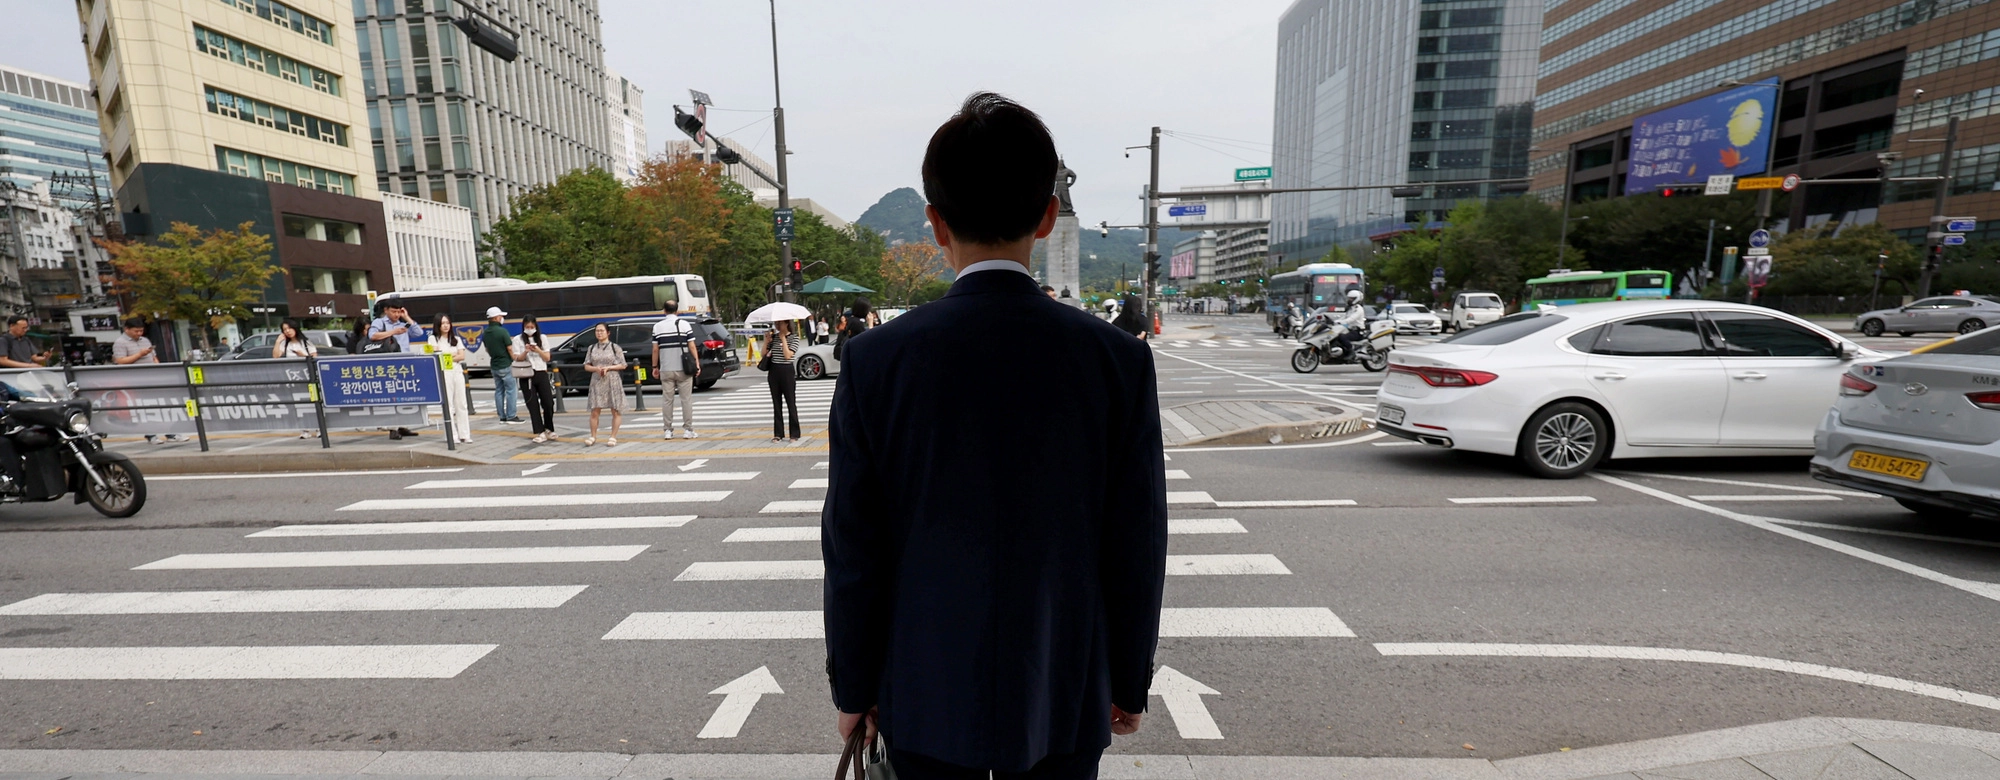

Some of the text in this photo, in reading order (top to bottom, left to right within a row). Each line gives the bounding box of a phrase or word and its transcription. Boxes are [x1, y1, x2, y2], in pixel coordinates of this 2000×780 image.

[340, 364, 415, 380] 보행신호준수!
[340, 379, 420, 395] 잠깐이면 됩니다.
[1887, 459, 1921, 477] 5472
